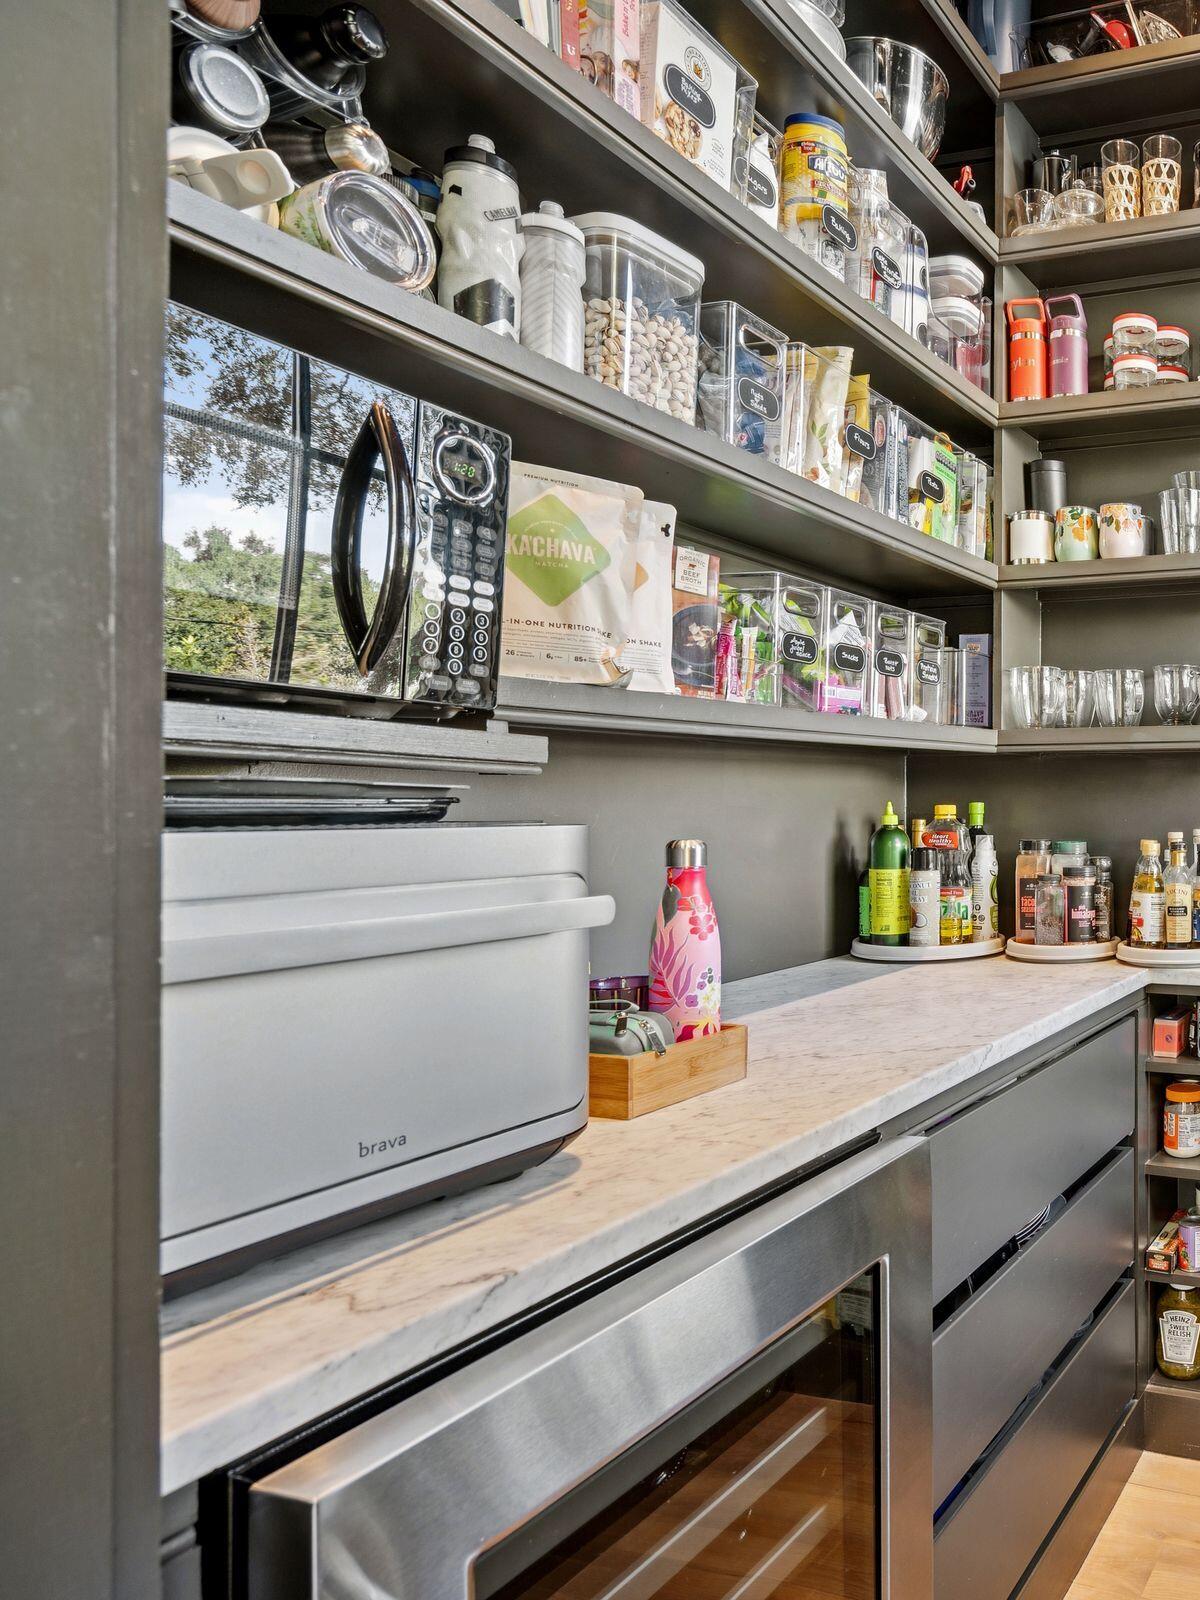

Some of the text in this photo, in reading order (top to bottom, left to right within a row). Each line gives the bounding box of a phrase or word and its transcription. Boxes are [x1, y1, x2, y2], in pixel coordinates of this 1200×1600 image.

[484, 206, 519, 222] CAMELBA
[680, 555, 706, 567] ORGANIC
[681, 576, 702, 586] BROTH
[928, 838, 952, 846] Healthy
[358, 1133, 407, 1158] brava
[1169, 1315, 1191, 1325] HEINZ
[1169, 1323, 1190, 1332] SWEET
[1167, 1330, 1192, 1339] RELISH
